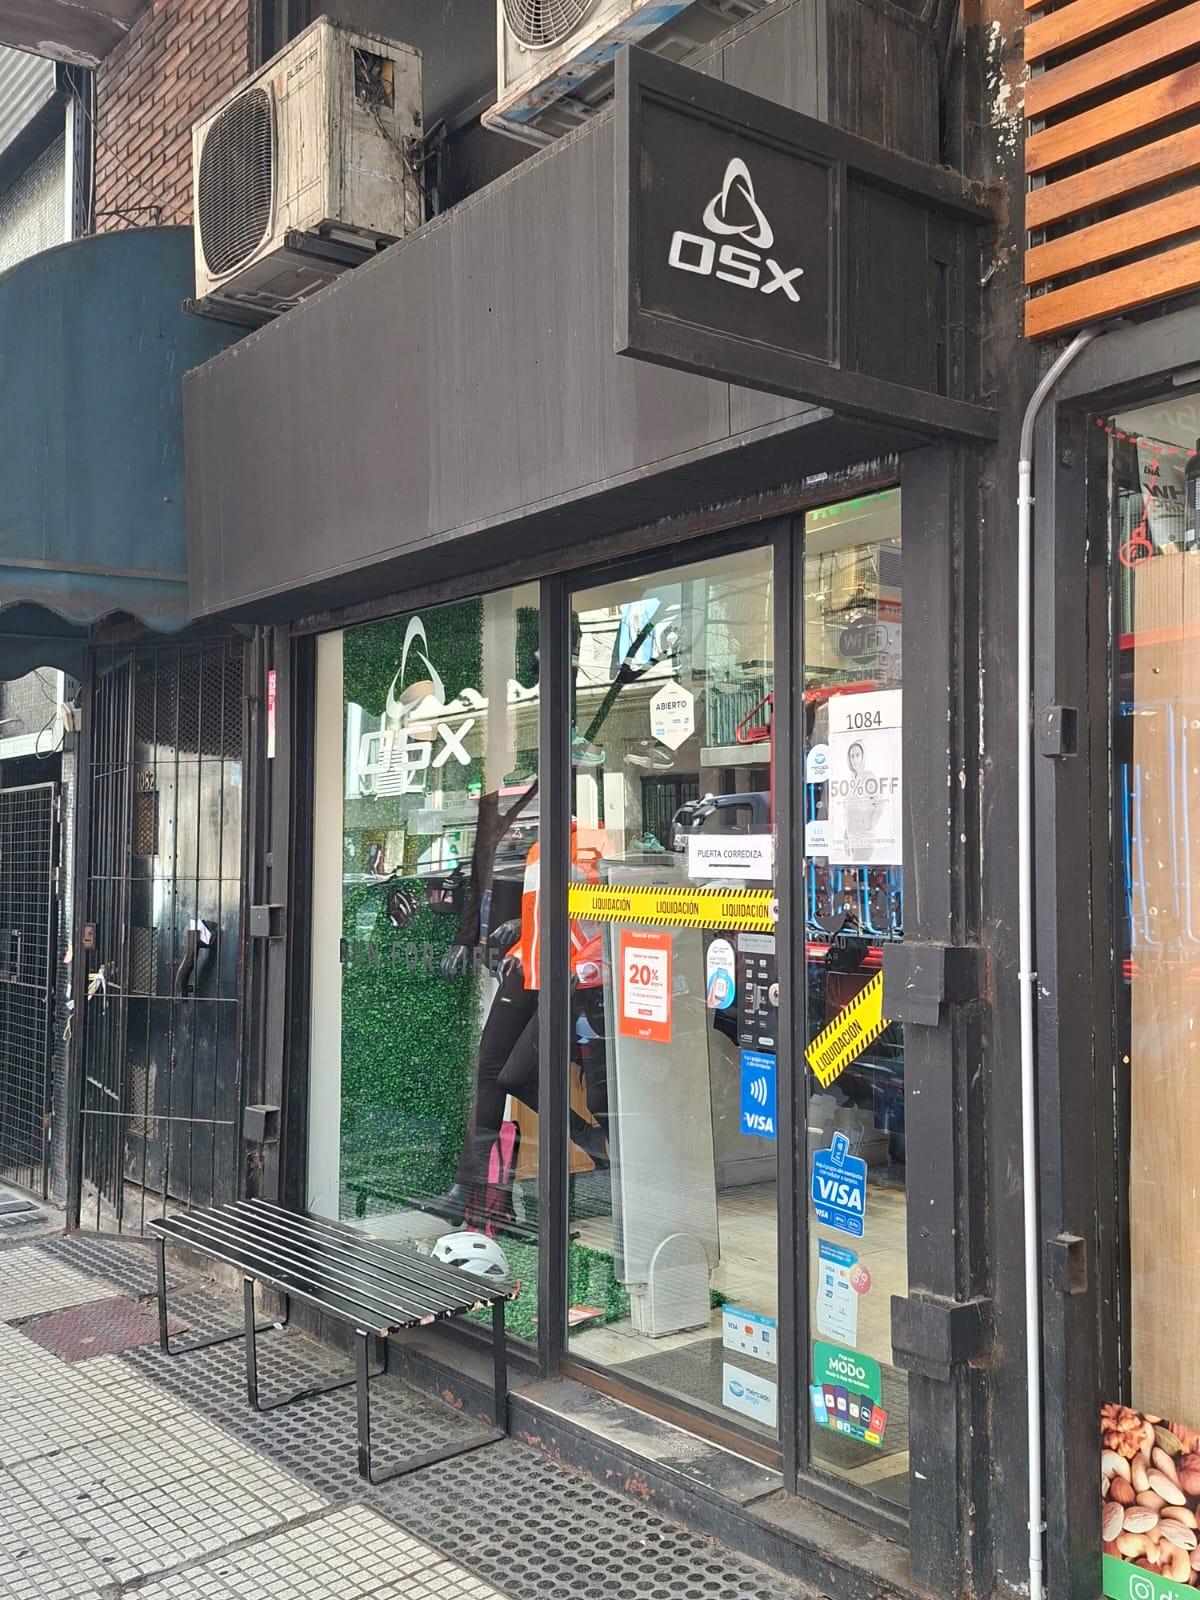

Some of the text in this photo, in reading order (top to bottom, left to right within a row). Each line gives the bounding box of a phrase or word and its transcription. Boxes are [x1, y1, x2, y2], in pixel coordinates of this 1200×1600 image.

[668, 230, 804, 302] OSX
[656, 700, 687, 711] ABIERTO
[846, 711, 882, 730] 1084
[697, 849, 762, 858] PUERTA CORREDIZA
[592, 896, 769, 918] LIQUIDACIÓN LIQUIDACIÓN LIQUIDACIÓN
[816, 1020, 863, 1072] LIQUIDACIÓN
[743, 1112, 774, 1133] VISA
[815, 1175, 863, 1212] VISA
[815, 1207, 829, 1219] VISA
[828, 1356, 866, 1380] MODO
[745, 1387, 771, 1403] mercado
